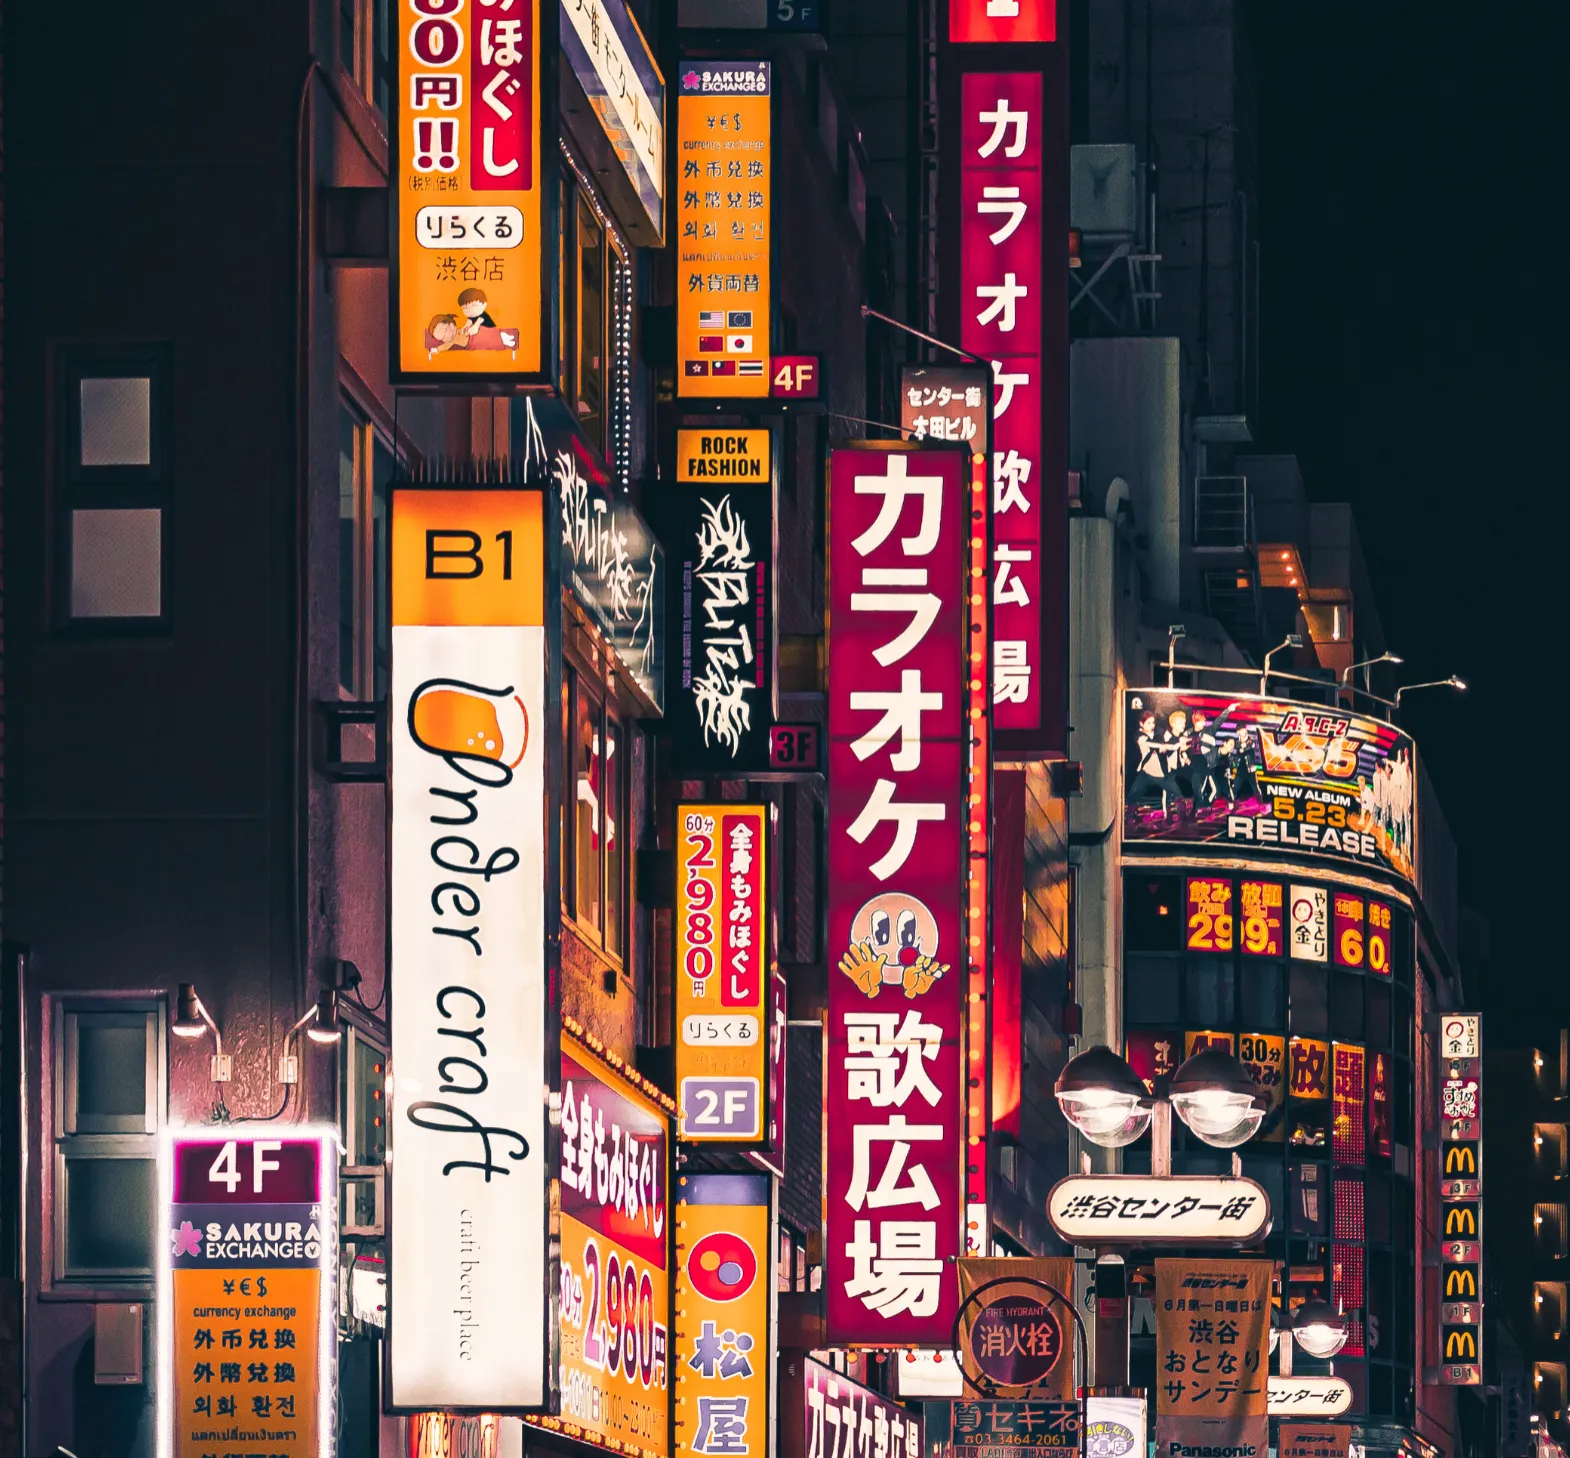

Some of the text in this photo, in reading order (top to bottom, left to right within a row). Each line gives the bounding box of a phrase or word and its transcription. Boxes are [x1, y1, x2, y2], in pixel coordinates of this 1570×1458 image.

[480, 0, 524, 177] ほぐし
[702, 71, 766, 83] SAKURA
[684, 141, 720, 152] currency
[427, 215, 512, 239] りらくる
[435, 256, 505, 282] 渋谷店
[689, 274, 760, 292] 外貨両替
[774, 365, 813, 391] 4F
[907, 386, 981, 407] センター街
[701, 437, 747, 454] ROCK
[688, 459, 761, 477] FASHION
[425, 529, 513, 580] B1
[777, 733, 811, 761] 3F
[1267, 785, 1351, 807] NEW ALBUM
[685, 815, 714, 832] 60分
[1273, 797, 1347, 829] 5.23
[1227, 816, 1376, 858] RELEASE
[729, 822, 755, 1000] 全身もみほぐし
[1314, 892, 1325, 957] やきとり
[689, 1022, 752, 1039] りらくる
[1241, 1037, 1281, 1063] 30分
[694, 1089, 748, 1125] 2F
[208, 1141, 283, 1193] 4F
[561, 1080, 664, 1239] 全身もみほぐし
[844, 1009, 944, 1320] 歌広場
[1060, 1195, 1257, 1221] 渋谷センター街
[206, 1222, 321, 1241] SAKURA
[206, 1242, 303, 1259] EXCHANGE
[560, 1261, 583, 1329] 0分
[193, 1306, 296, 1320] currency exchange
[985, 1306, 1045, 1318] FIRE HYDRANT
[980, 1323, 1053, 1358] 消火栓
[1189, 1319, 1239, 1345] 渋谷
[1164, 1350, 1261, 1375] おとなり
[688, 1320, 754, 1455] 松屋
[1164, 1380, 1262, 1404] サンデー
[193, 1395, 296, 1417] 외화 환전
[986, 1403, 1079, 1433] セキネ
[975, 1434, 1067, 1446] 03-3464-2061
[1169, 1441, 1256, 1458] Panasonic
